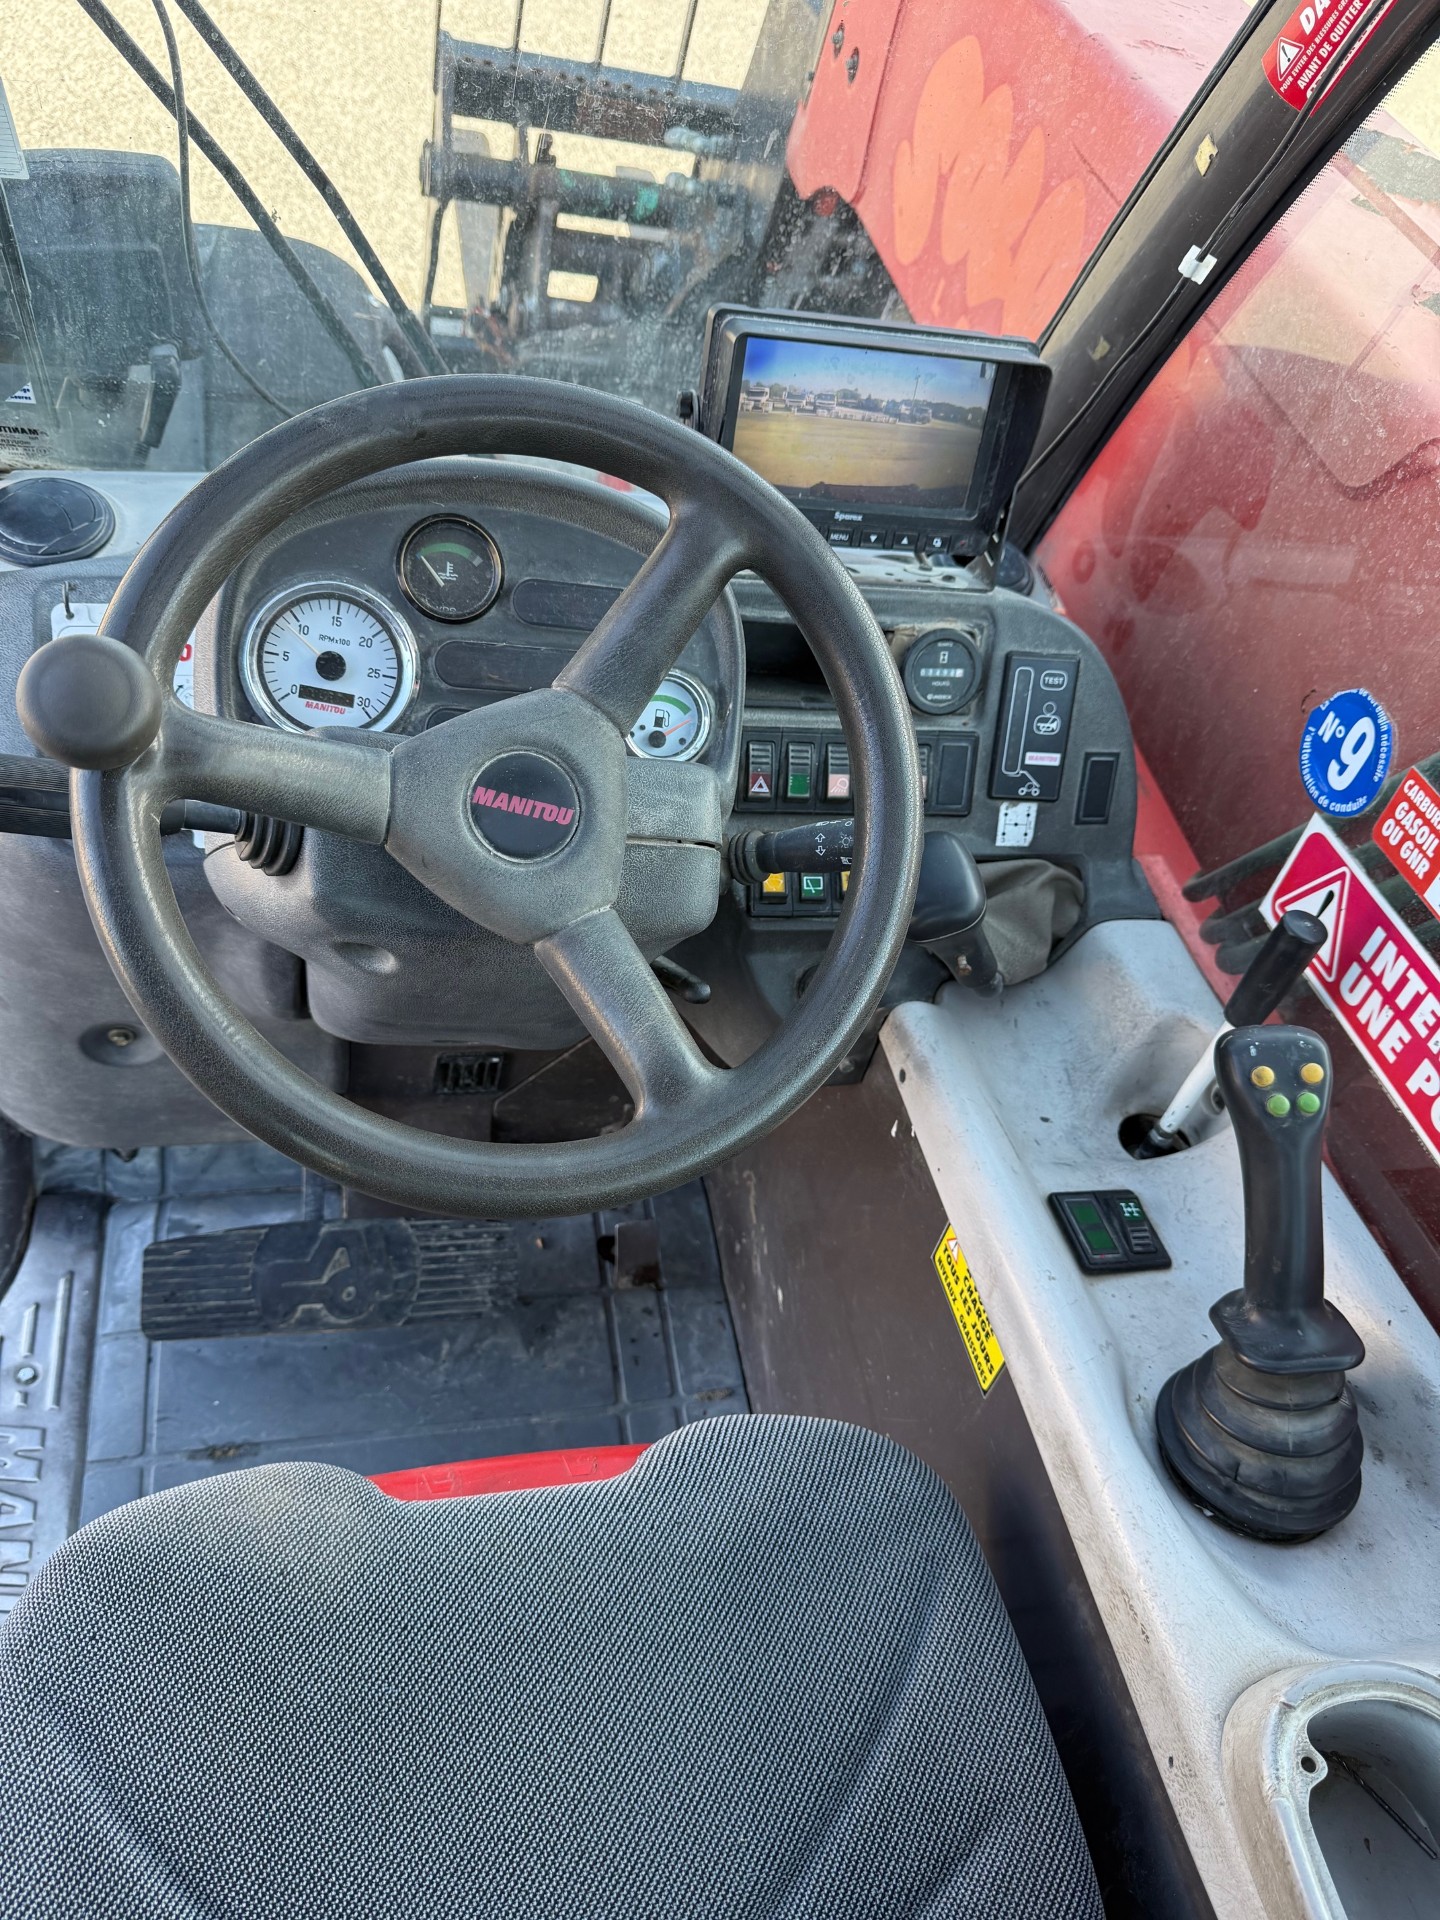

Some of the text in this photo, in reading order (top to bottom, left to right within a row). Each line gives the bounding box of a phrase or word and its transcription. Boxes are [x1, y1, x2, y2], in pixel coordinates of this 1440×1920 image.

[1279, 76, 1294, 93] POUR
[1291, 55, 1308, 78] EVITER
[1307, 43, 1317, 57] DES
[1314, 9, 1339, 44] BLESSURES
[1297, 56, 1322, 90] AVANT
[1319, 41, 1333, 58] DE
[1329, 0, 1364, 42] QUITTER
[834, 511, 863, 521] Sparex
[830, 533, 849, 541] MENU
[298, 624, 309, 636] 10
[331, 616, 343, 627] 15
[358, 636, 373, 648] 20
[282, 651, 290, 661] 5
[367, 668, 381, 679] 25
[1044, 677, 1064, 685] TEST
[290, 684, 298, 695] 0
[357, 696, 371, 708] 30
[305, 701, 346, 715] MANITOU
[1327, 716, 1376, 791] 9
[1301, 726, 1368, 813] l'autorisation de conduite
[472, 785, 576, 826] MANITOU
[1394, 801, 1440, 859] GASOIL
[1381, 818, 1431, 880] OU GNR
[1339, 961, 1440, 1135] UNE P
[937, 1256, 958, 1306] NIVEAUX
[959, 1314, 988, 1385] GRAISSAGES
[943, 1243, 960, 1286] TOUS
[959, 1286, 972, 1316] LES
[971, 1320, 995, 1376] JOURS
[963, 1275, 991, 1342] CHARGE
